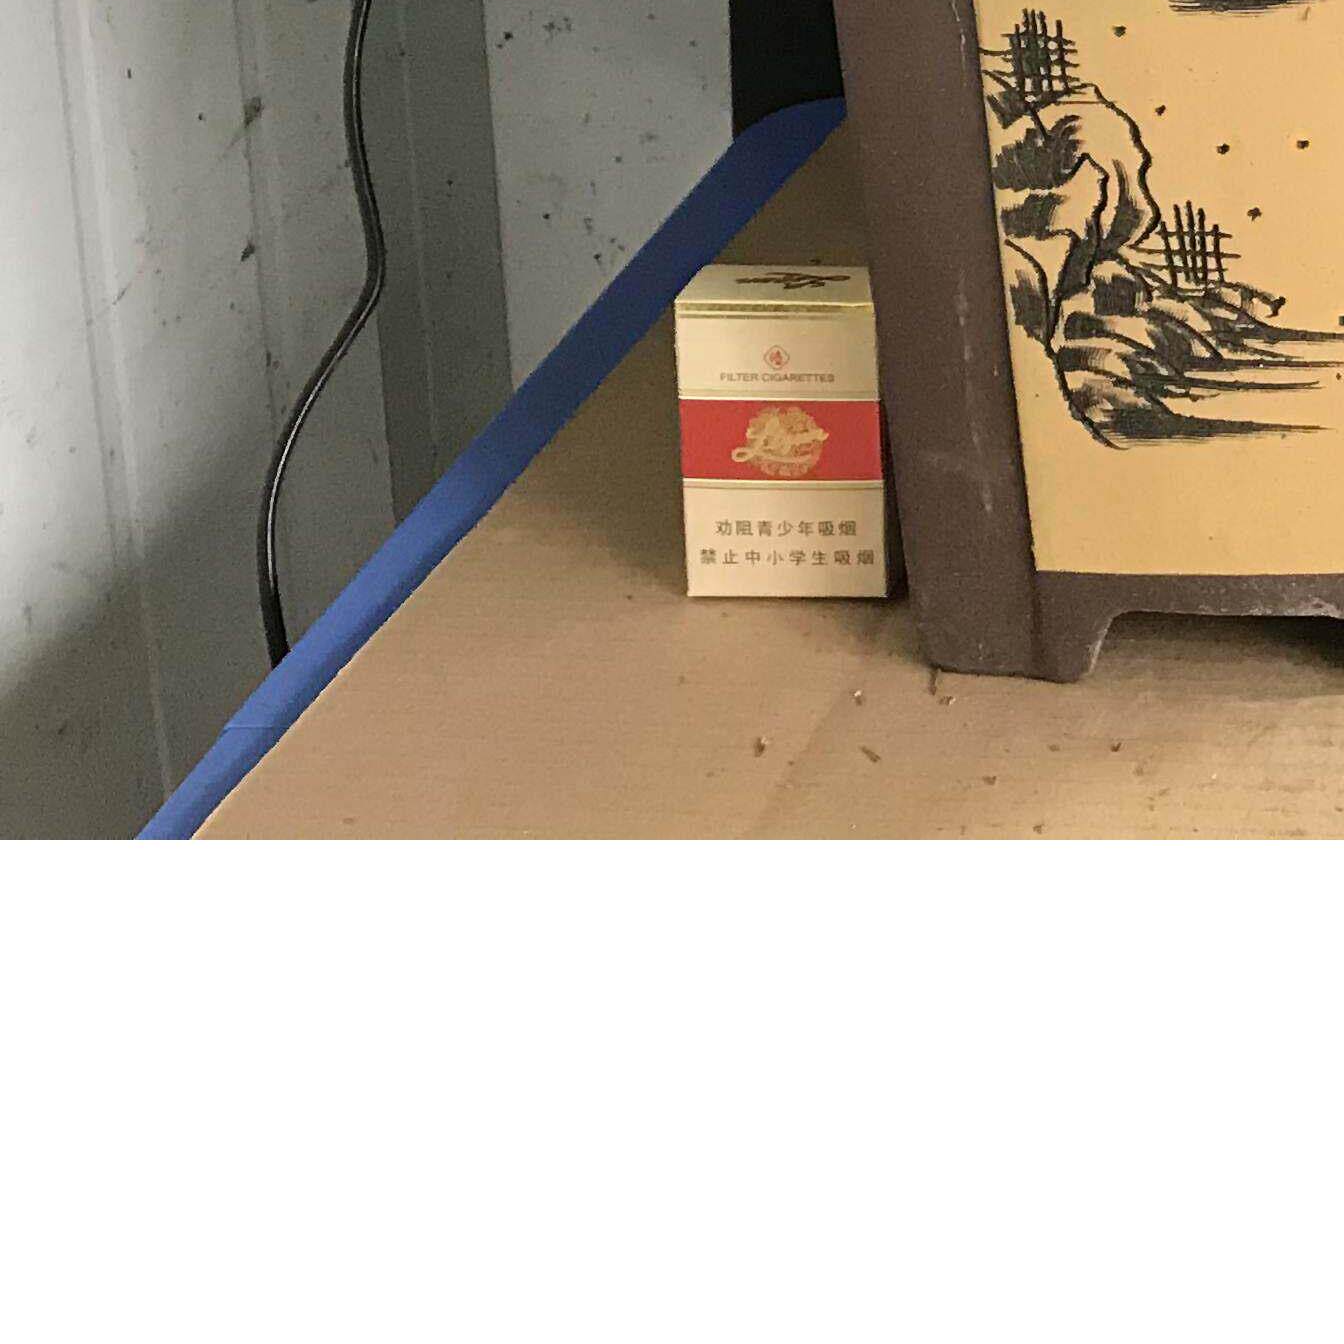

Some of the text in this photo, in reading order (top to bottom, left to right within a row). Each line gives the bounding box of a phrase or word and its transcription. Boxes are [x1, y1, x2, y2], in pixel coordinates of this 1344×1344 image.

[720, 372, 835, 383] FILTER CIGARETTES
[715, 519, 857, 537] 劝阻青少年吸烟
[699, 548, 875, 566] 禁止中小学生吸烟
